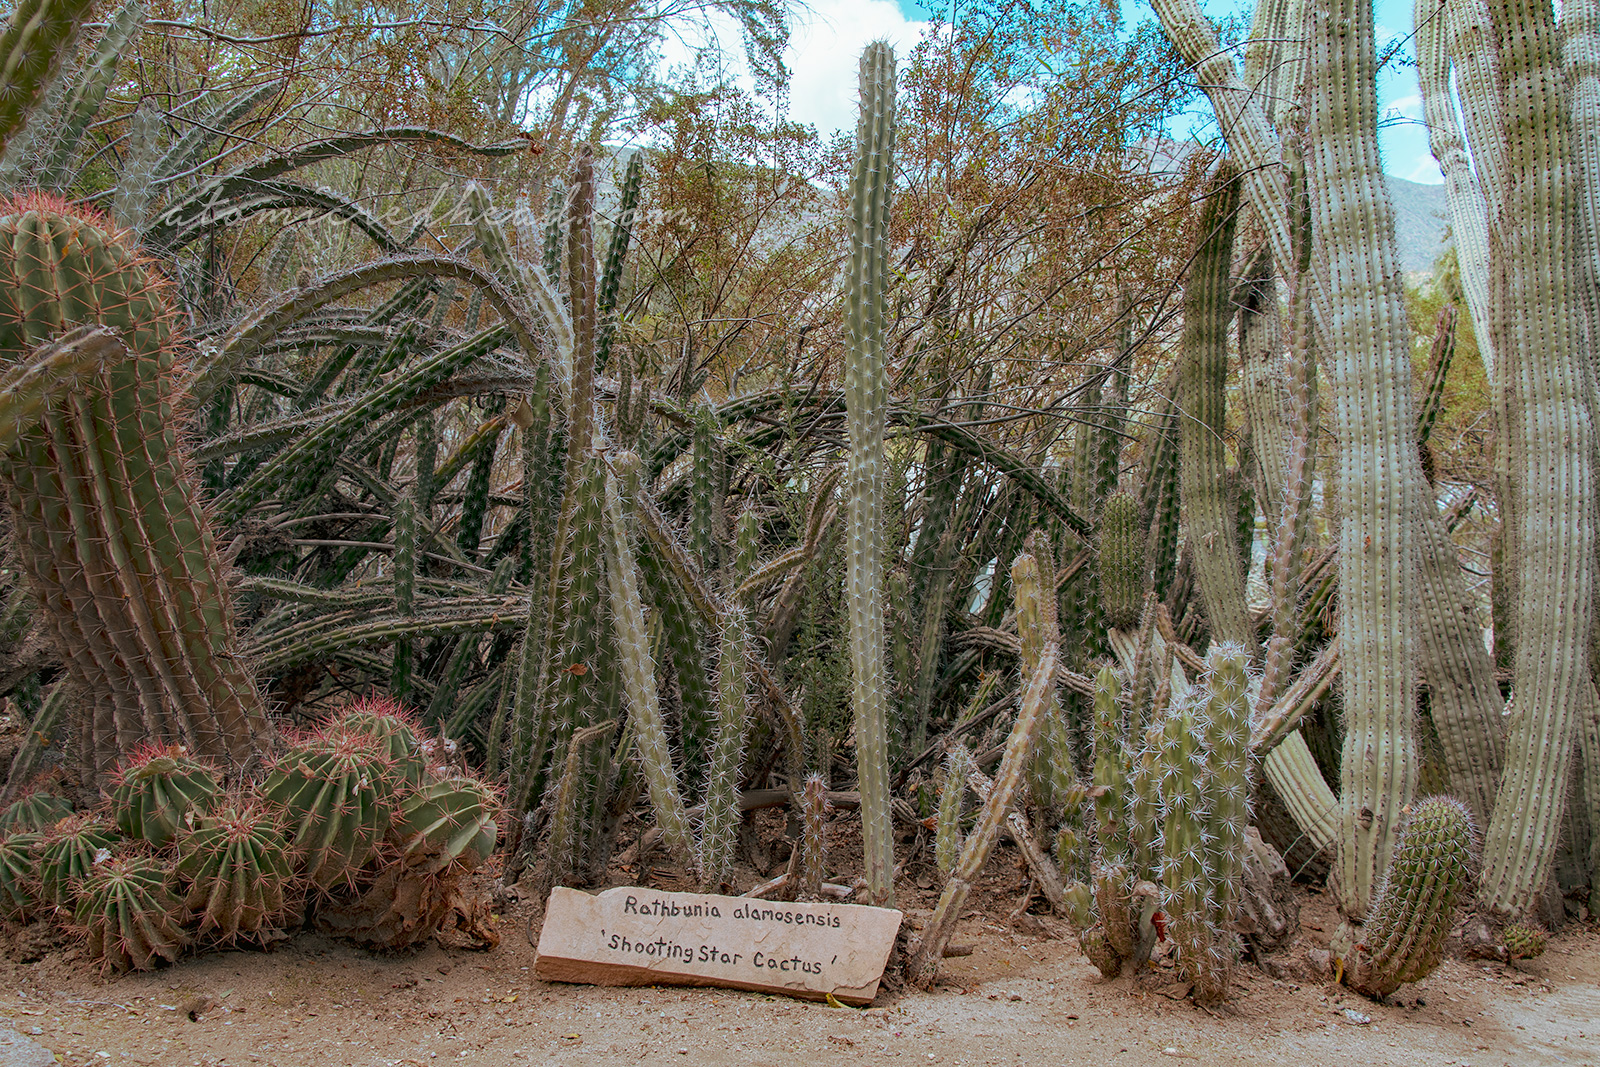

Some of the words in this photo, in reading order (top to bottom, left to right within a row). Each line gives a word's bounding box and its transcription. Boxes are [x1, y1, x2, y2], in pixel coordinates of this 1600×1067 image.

[623, 895, 721, 919] Rathbunia
[733, 902, 841, 929] alamosensis
[698, 945, 743, 966] Star
